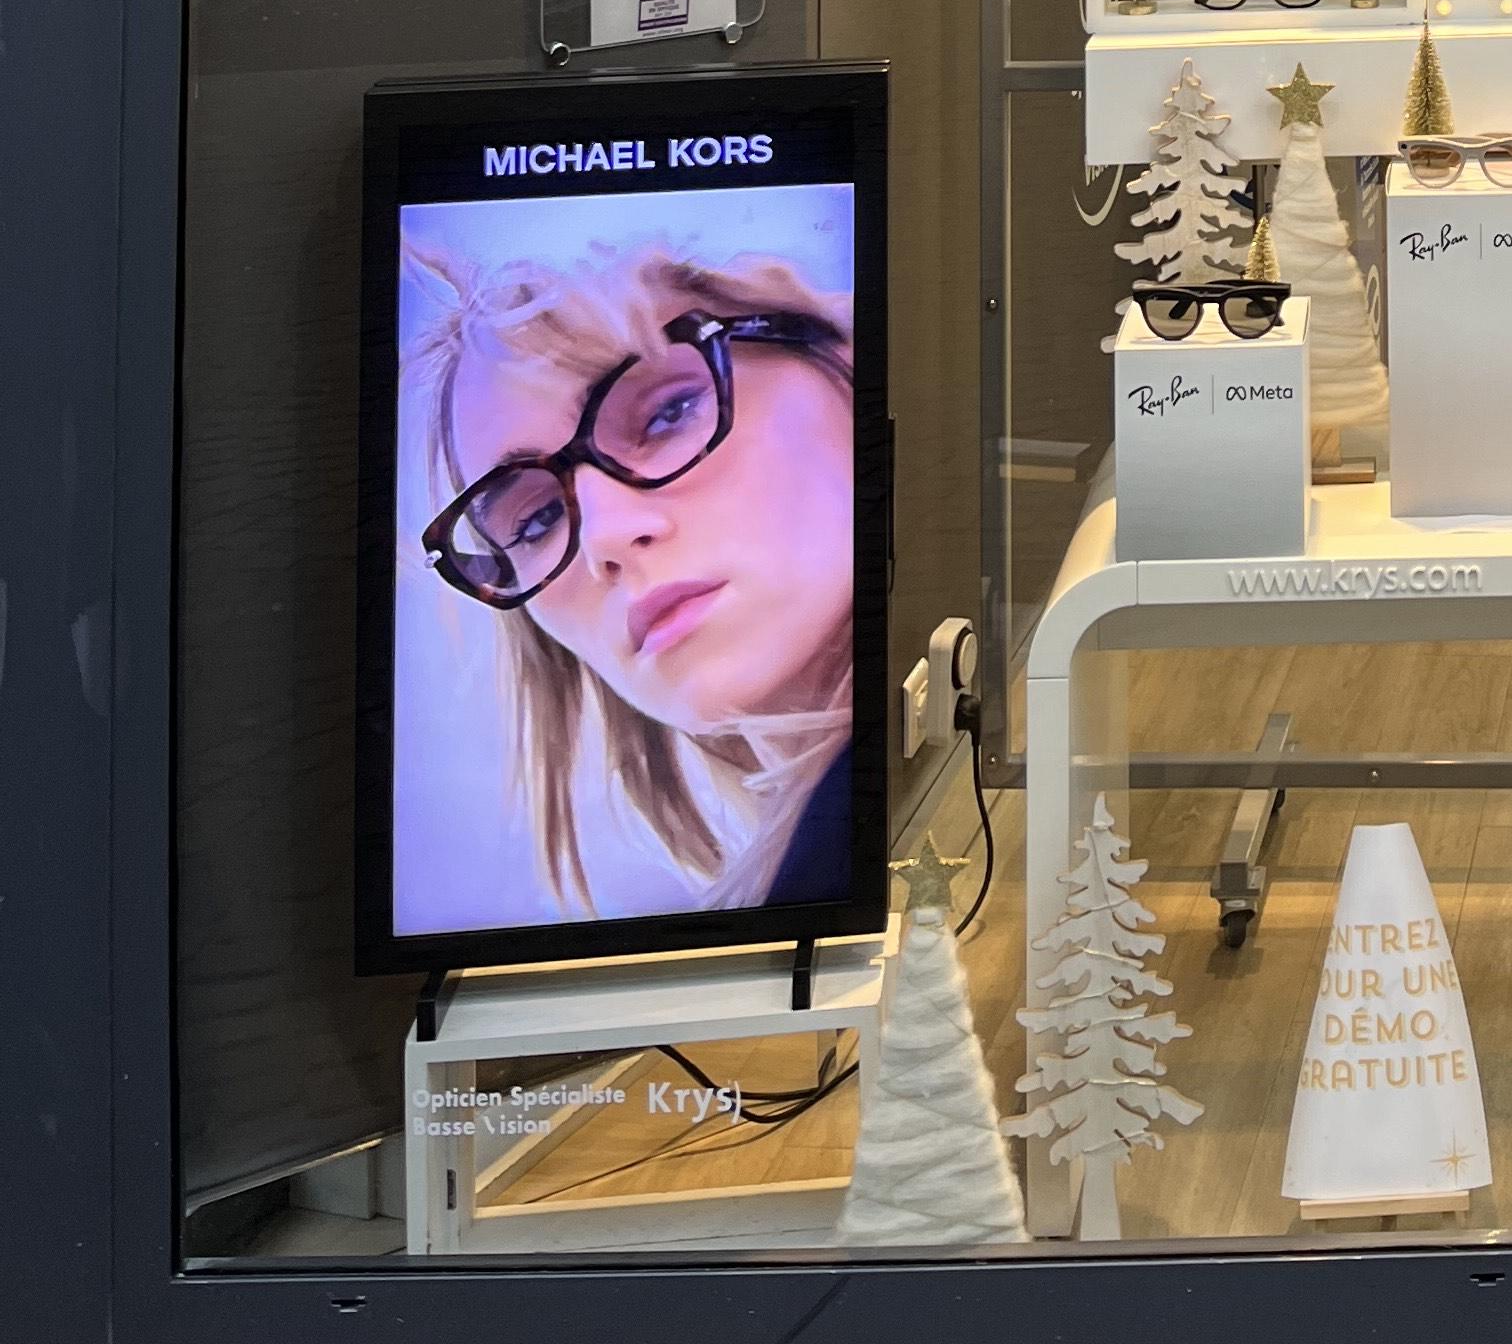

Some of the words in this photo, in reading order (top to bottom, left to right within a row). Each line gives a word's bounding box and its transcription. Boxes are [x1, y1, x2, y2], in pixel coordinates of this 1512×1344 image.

[483, 139, 656, 177] MICHAEL
[667, 134, 774, 169] KORS
[1400, 223, 1470, 262] Ray-Ban
[1128, 374, 1201, 416] Ray-Ban
[1249, 384, 1294, 401] Meta
[1225, 561, 1484, 599] www.krys.com
[1324, 1006, 1438, 1047] DÉMO
[411, 1086, 502, 1111] Opticien
[510, 1083, 626, 1110] Spécialiste
[648, 1081, 734, 1123] Krys
[412, 1116, 476, 1137] Basse
